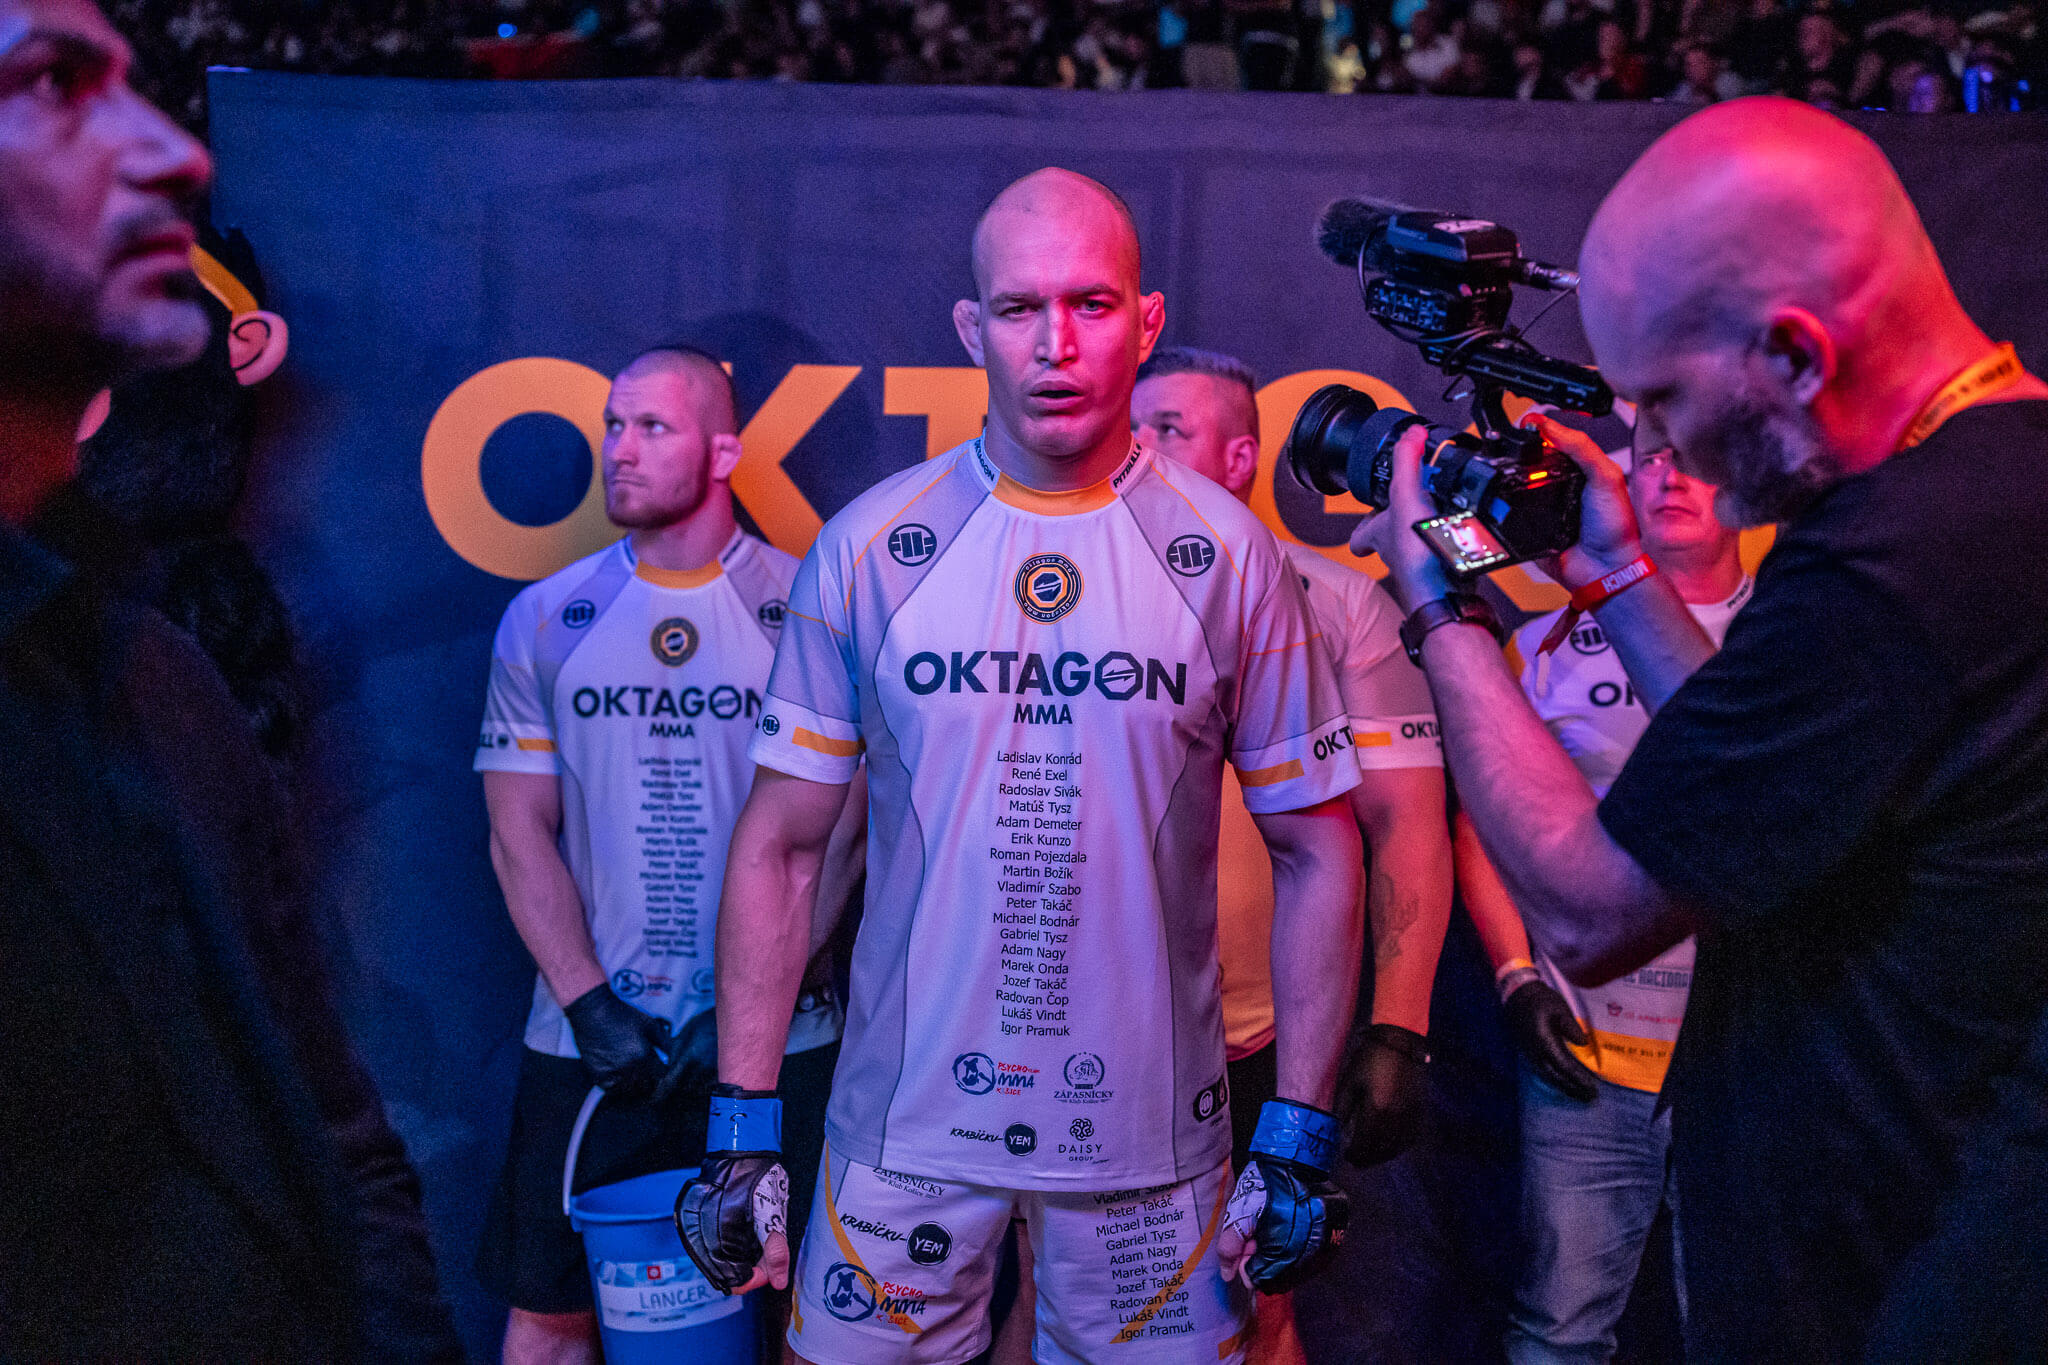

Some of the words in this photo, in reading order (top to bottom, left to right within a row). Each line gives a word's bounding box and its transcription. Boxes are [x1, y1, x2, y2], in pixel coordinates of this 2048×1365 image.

[1601, 557, 1650, 593] MUNICH
[904, 650, 1187, 705] OKTAGON
[1013, 703, 1073, 725] MMA
[649, 723, 696, 738] MMA
[997, 751, 1041, 764] Ladislav
[1045, 752, 1082, 765] Konrád
[1012, 768, 1041, 780] René
[1045, 770, 1068, 781] Exel
[999, 784, 1050, 796] Radoslav
[1054, 785, 1082, 798] Sivák
[1009, 801, 1044, 812] Matúš
[1048, 802, 1072, 816] Tysz
[996, 816, 1030, 828] Adam
[1034, 818, 1082, 831] Demeter
[1011, 833, 1033, 844] Erik
[1037, 834, 1071, 847] Kunzo
[990, 848, 1030, 861] Roman
[1034, 850, 1087, 864] Pojezdala
[1003, 865, 1040, 877] Martin
[1044, 866, 1073, 879] Božík
[997, 881, 1046, 893] Vladimír
[1048, 883, 1081, 896] Szabo
[1006, 898, 1037, 909] Peter
[1041, 899, 1072, 911] Takáč
[993, 912, 1036, 925] Michael
[1040, 915, 1080, 927] Bodnár
[1000, 928, 1040, 941] Gabriel
[1043, 931, 1068, 945] Tysz
[1001, 944, 1033, 956] Adam
[1037, 947, 1066, 961] Nagy
[1001, 959, 1034, 973] Marek
[1038, 963, 1069, 974] Onda
[1002, 975, 1031, 988] Jozef
[1034, 977, 1067, 990] Takáč
[996, 990, 1042, 1005] Radovan
[1046, 991, 1070, 1007] Čop
[1001, 1005, 1032, 1020] Lukáš
[1036, 1009, 1067, 1021] Vindt
[1001, 1021, 1023, 1035] Igor
[1026, 1025, 1070, 1036] Pramuk
[997, 1061, 1028, 1073] PSYCHO
[998, 1073, 1035, 1088] MMA
[1009, 1135, 1031, 1147] YEM
[1058, 1144, 1103, 1154] DAISY
[1106, 1204, 1137, 1219] Peter
[1141, 1195, 1174, 1212] Takáč
[1095, 1219, 1140, 1238] Michael
[1144, 1209, 1184, 1227] Bodnár
[915, 1237, 944, 1256] YEM
[1105, 1233, 1147, 1251] Gabriel
[1150, 1229, 1177, 1244] Tysz
[1109, 1251, 1143, 1266] Adam
[1147, 1245, 1177, 1259] Nagy
[1111, 1265, 1148, 1280] Marek
[1152, 1259, 1184, 1274] Onda
[882, 1281, 923, 1299] PSYCHO
[1115, 1280, 1146, 1295] Jozef
[1150, 1273, 1184, 1289] Takáč
[639, 1284, 711, 1310] LANCER
[880, 1295, 927, 1315] MMA
[1110, 1294, 1162, 1310] Radovan
[1165, 1288, 1189, 1303] Čop
[1119, 1309, 1154, 1324] Lukáš
[1157, 1305, 1190, 1320] Vindt
[1120, 1327, 1145, 1341] Igor
[1150, 1320, 1195, 1337] Pramuk
